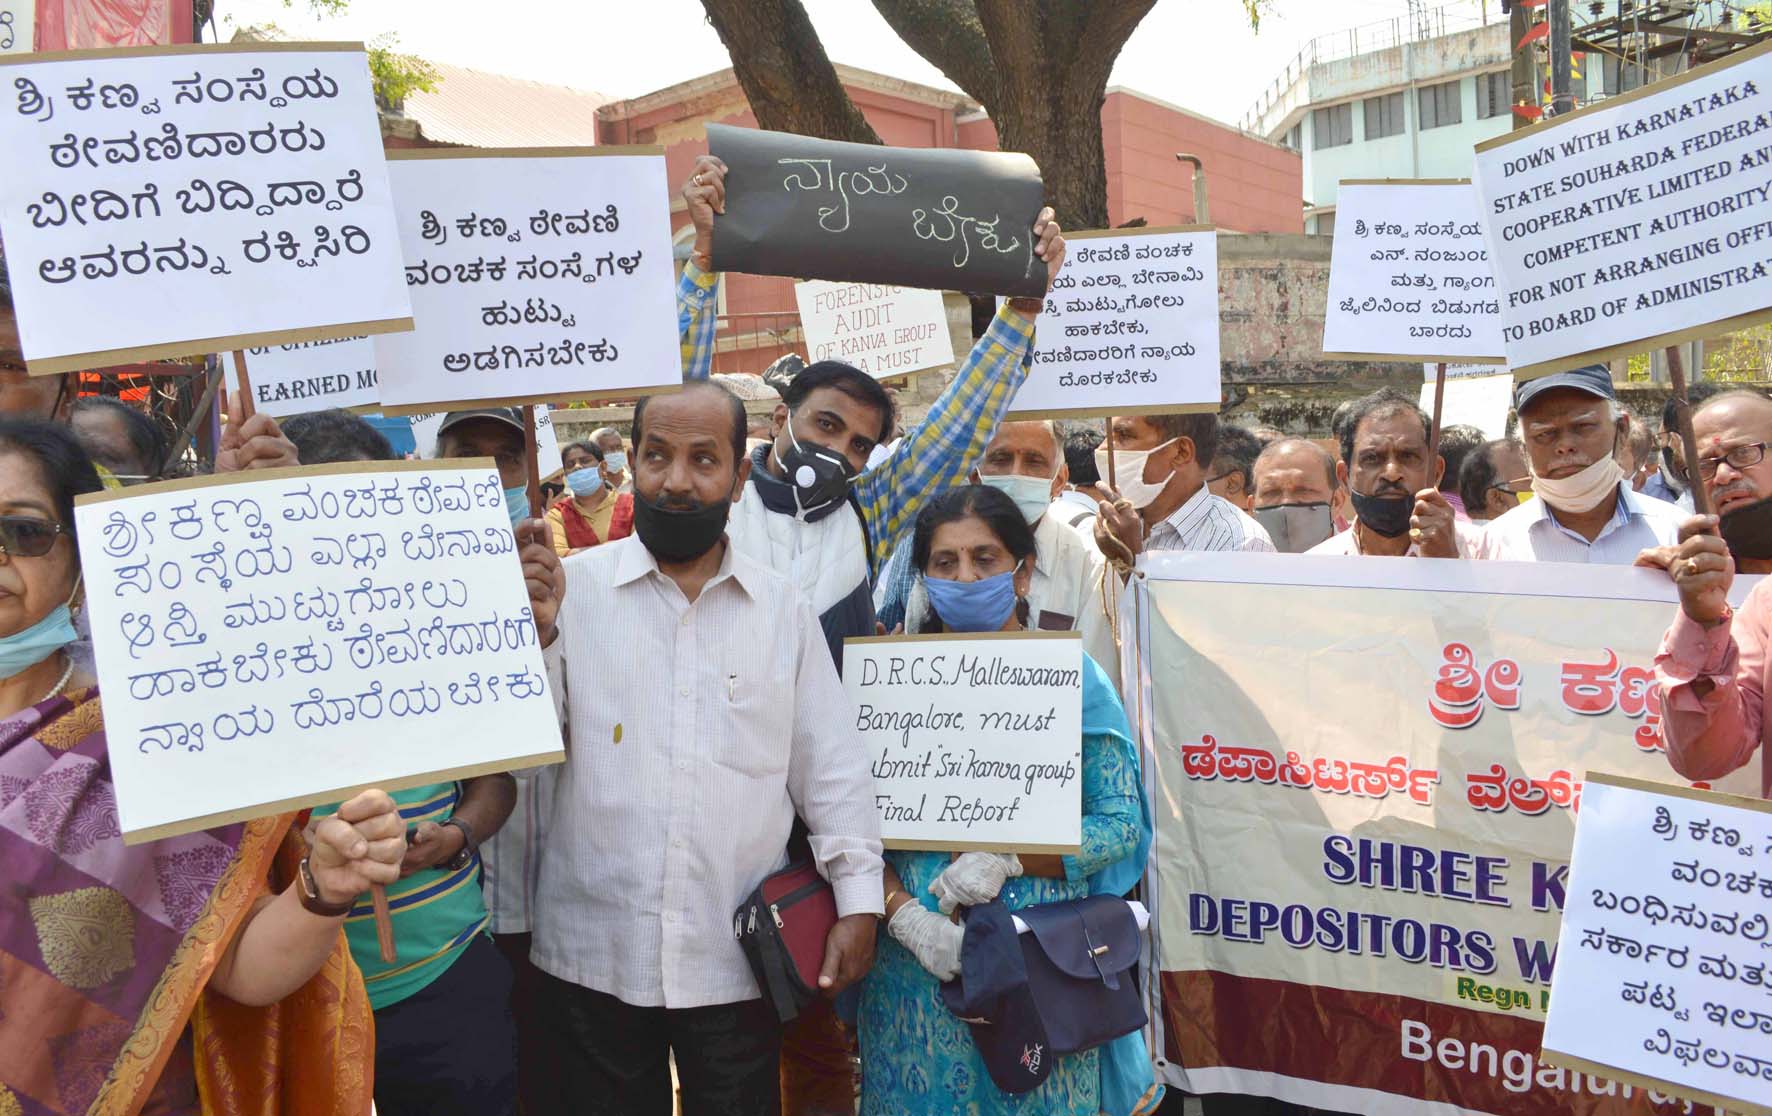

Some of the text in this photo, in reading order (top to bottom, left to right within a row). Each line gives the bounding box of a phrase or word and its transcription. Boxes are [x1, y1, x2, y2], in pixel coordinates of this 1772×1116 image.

[65, 77, 161, 115] ಕಣ್ವ
[171, 67, 339, 108] ಸಂಸ್ಥೆಯ
[50, 120, 326, 169] ಠೇವಣಿದಾರರು
[1503, 80, 1760, 178] DOWN WITH KARNATAKA
[1493, 110, 1772, 215] STATE SOUHARDA FEDERA
[26, 169, 365, 229] ಬೀದಿಗೆ ಬಿದ್ದಿದ್ದಾರೆ
[1502, 144, 1772, 242] COOPERATIVE LIMITED AN
[456, 211, 521, 243] ಕಣ್ವ
[529, 204, 620, 237] ಠೇವಣಿ
[1523, 179, 1772, 270] COMPETENT AUTHORITY
[242, 224, 371, 268] ರಕ್ಷಿಸಿರಿ
[1077, 243, 1130, 264] ಠೇವಣಿ
[1136, 242, 1194, 260] ವಂಚಕ
[405, 249, 643, 286] ವಂಚಕ ಸಂಸ್ಥೆಗಳ
[1081, 273, 1127, 290] ಎಲ್ಲಾ
[1132, 266, 1204, 286] ಬೇನಾಮಿ
[1391, 272, 1438, 291] ಮತ್ತು
[1508, 284, 1545, 308] FOR
[1549, 272, 1587, 298] NOT
[1593, 238, 1721, 286] ARRANGING
[481, 297, 576, 328] ಹುಟ್ಟು
[834, 302, 895, 335] AUDIT
[1066, 294, 1185, 314] ಮುಟ್ಟುಗೋಲು
[1502, 258, 1772, 344] TO BOARD OF ADMINISTRA
[816, 322, 937, 362] OF KANVA GROUP
[1409, 323, 1472, 339] ಬಾರದು
[443, 337, 620, 373] ಅಡಗಿಸಬೇಕು
[877, 347, 923, 372] MUST
[1141, 341, 1196, 361] ನ್ಯಾಯ
[257, 373, 351, 403] EARNED
[949, 653, 1081, 688] Malleswaram,
[1428, 642, 1519, 726] ಶ್ರೀ
[856, 703, 1056, 749] Bangalore, must
[871, 747, 932, 779] ubmit
[875, 794, 1020, 829] Final Report
[1688, 818, 1753, 857] ಕಣ್ವ
[1322, 833, 1568, 912] SHREE K
[1189, 893, 1557, 985] DEPOSITORS W
[1580, 927, 1690, 969] ಸರ್ಕಾರ
[1457, 975, 1532, 1010] Regn
[1621, 980, 1690, 1023] ಪಟ್ಟ
